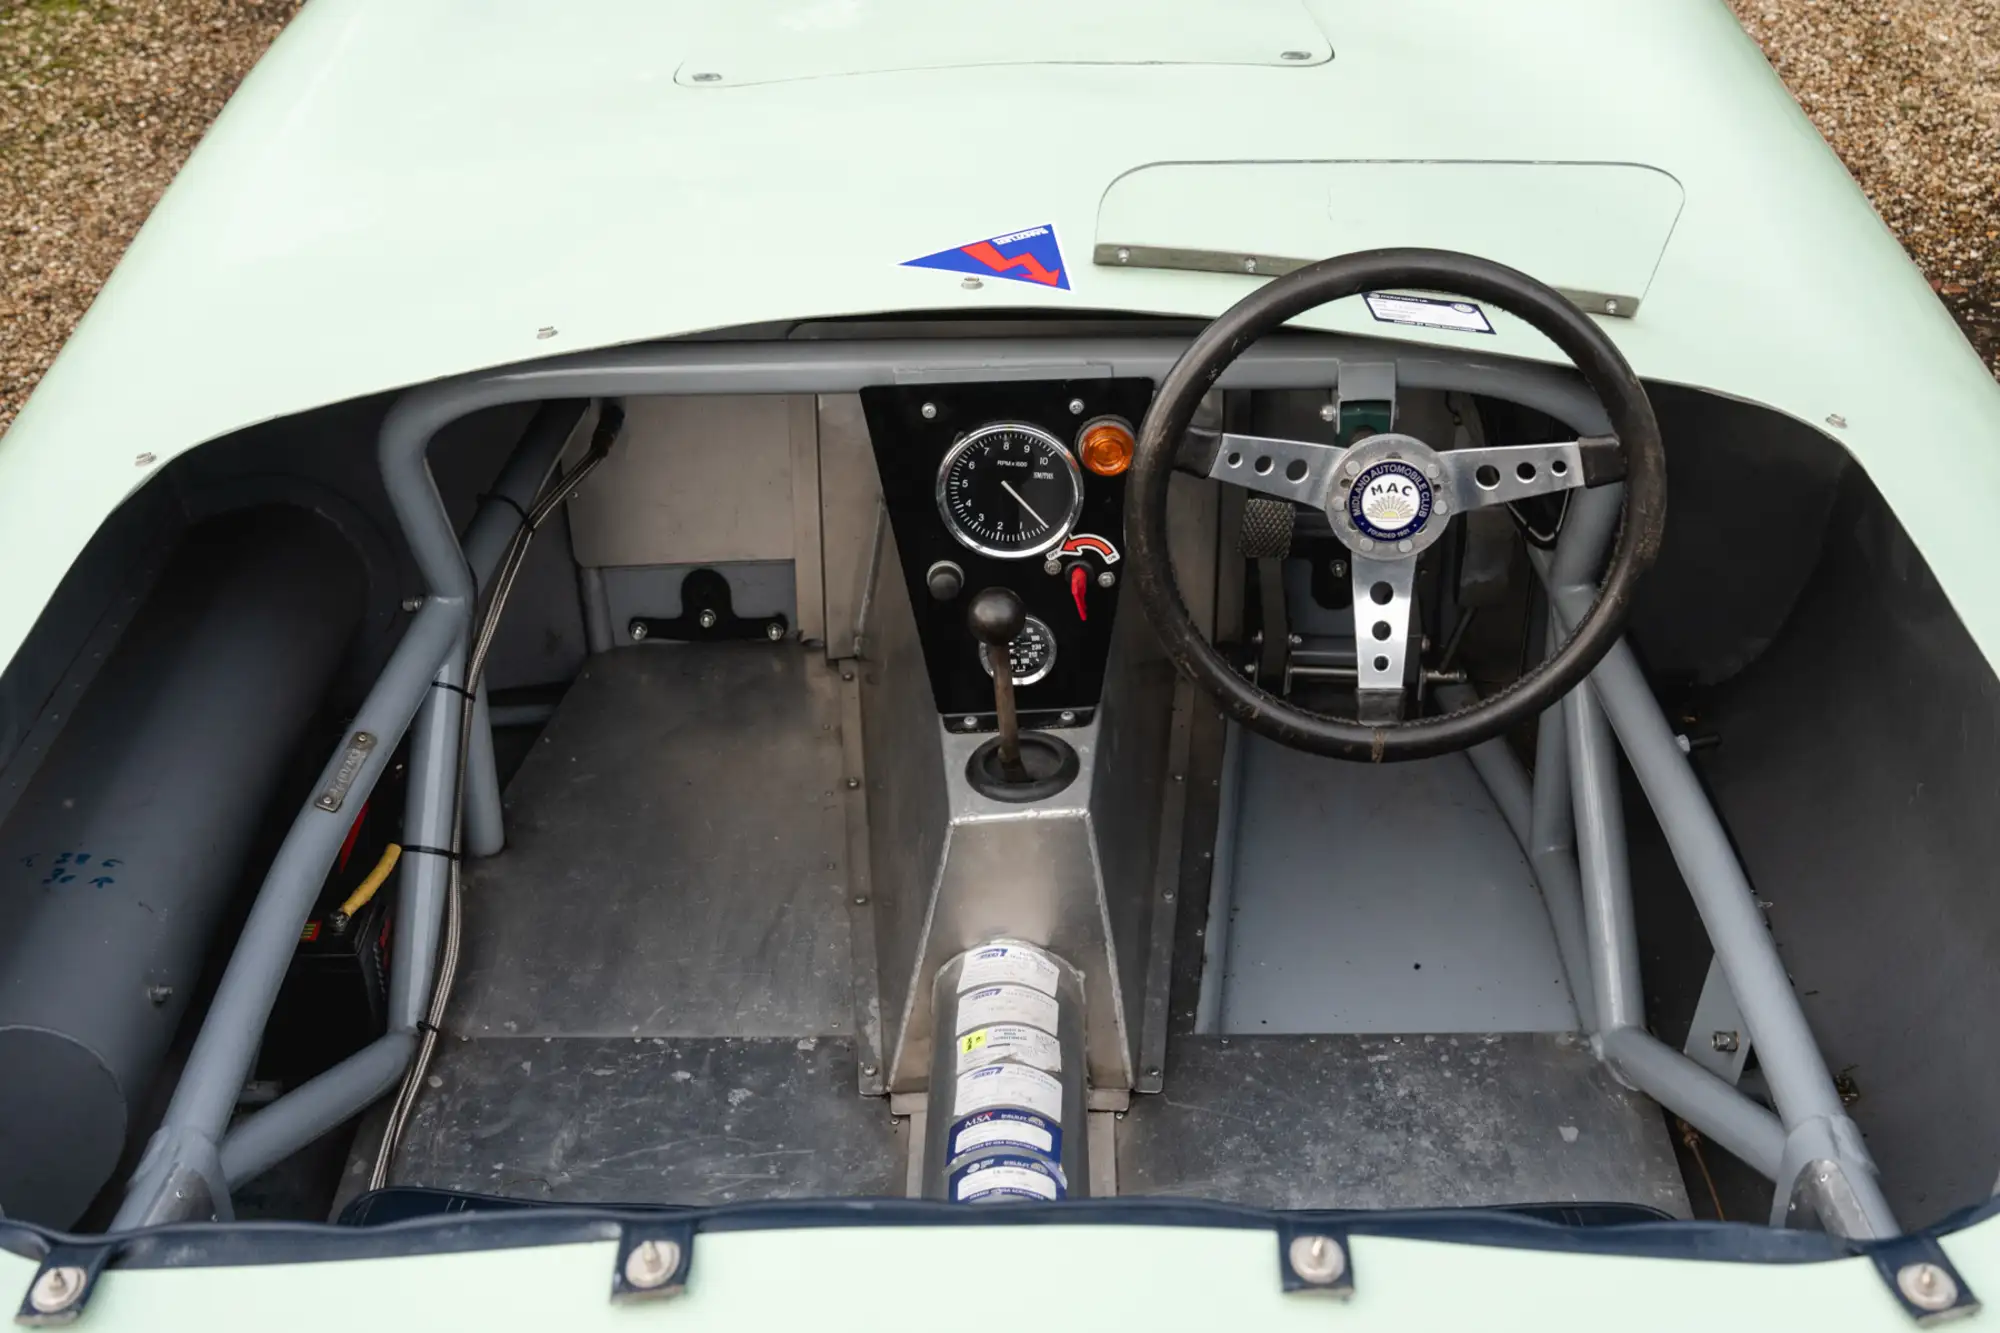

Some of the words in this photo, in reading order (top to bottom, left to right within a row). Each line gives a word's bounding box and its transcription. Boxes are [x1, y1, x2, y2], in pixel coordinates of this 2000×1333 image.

[1003, 442, 1009, 450] 8
[1024, 445, 1030, 453] 9
[984, 447, 990, 455] 7
[968, 461, 975, 469] 6
[1040, 457, 1048, 465] 10
[962, 479, 968, 488] 5
[1352, 475, 1370, 516] MIDLAND
[1370, 464, 1427, 491] AUTOMOBILE
[1418, 492, 1430, 518] CLUB
[1371, 483, 1413, 496] MAC
[965, 499, 971, 507] 4
[978, 513, 984, 521] 3
[997, 521, 1003, 530] 2
[1367, 528, 1396, 538] FOUNDED
[965, 1114, 991, 1128] MSA
